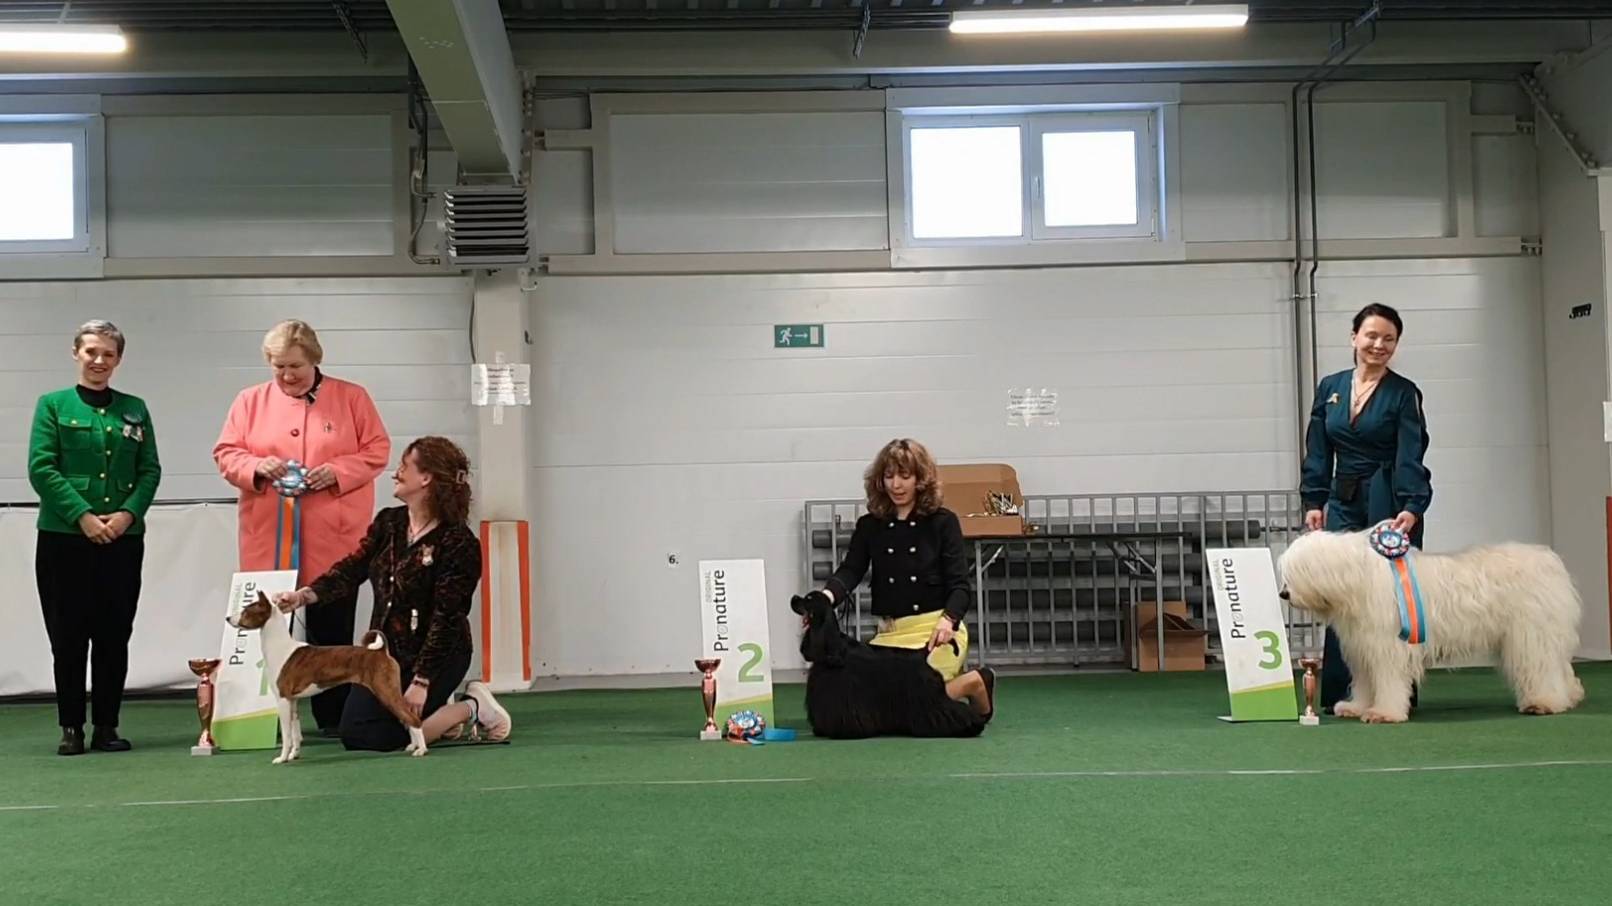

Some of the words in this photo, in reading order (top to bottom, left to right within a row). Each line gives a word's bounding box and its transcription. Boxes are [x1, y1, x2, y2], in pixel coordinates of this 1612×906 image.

[229, 582, 256, 665] Pronure
[713, 569, 729, 651] Pronature
[1222, 558, 1246, 638] Pronature
[737, 642, 764, 683] 2
[1253, 630, 1282, 670] 3
